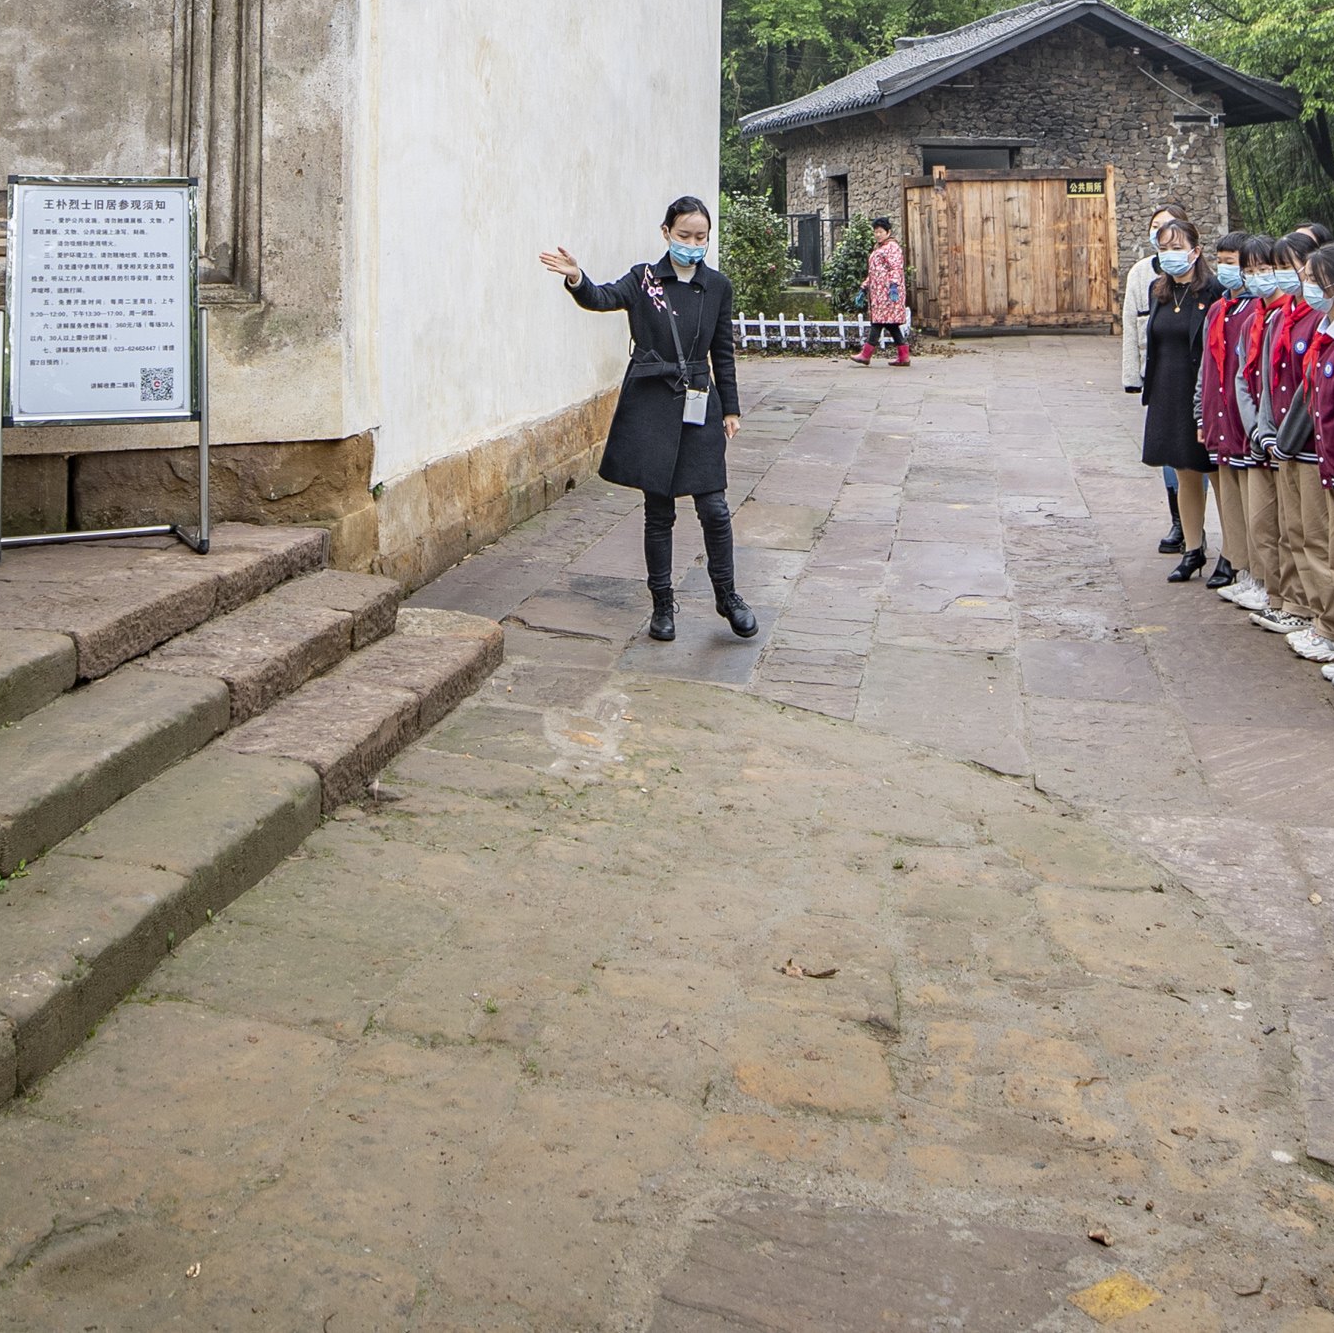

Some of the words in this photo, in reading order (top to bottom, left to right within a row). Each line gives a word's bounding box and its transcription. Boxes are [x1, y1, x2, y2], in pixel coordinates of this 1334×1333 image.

[1070, 182, 1102, 193] 公共厕所
[43, 199, 167, 210] 王朴烈士旧居参观须知
